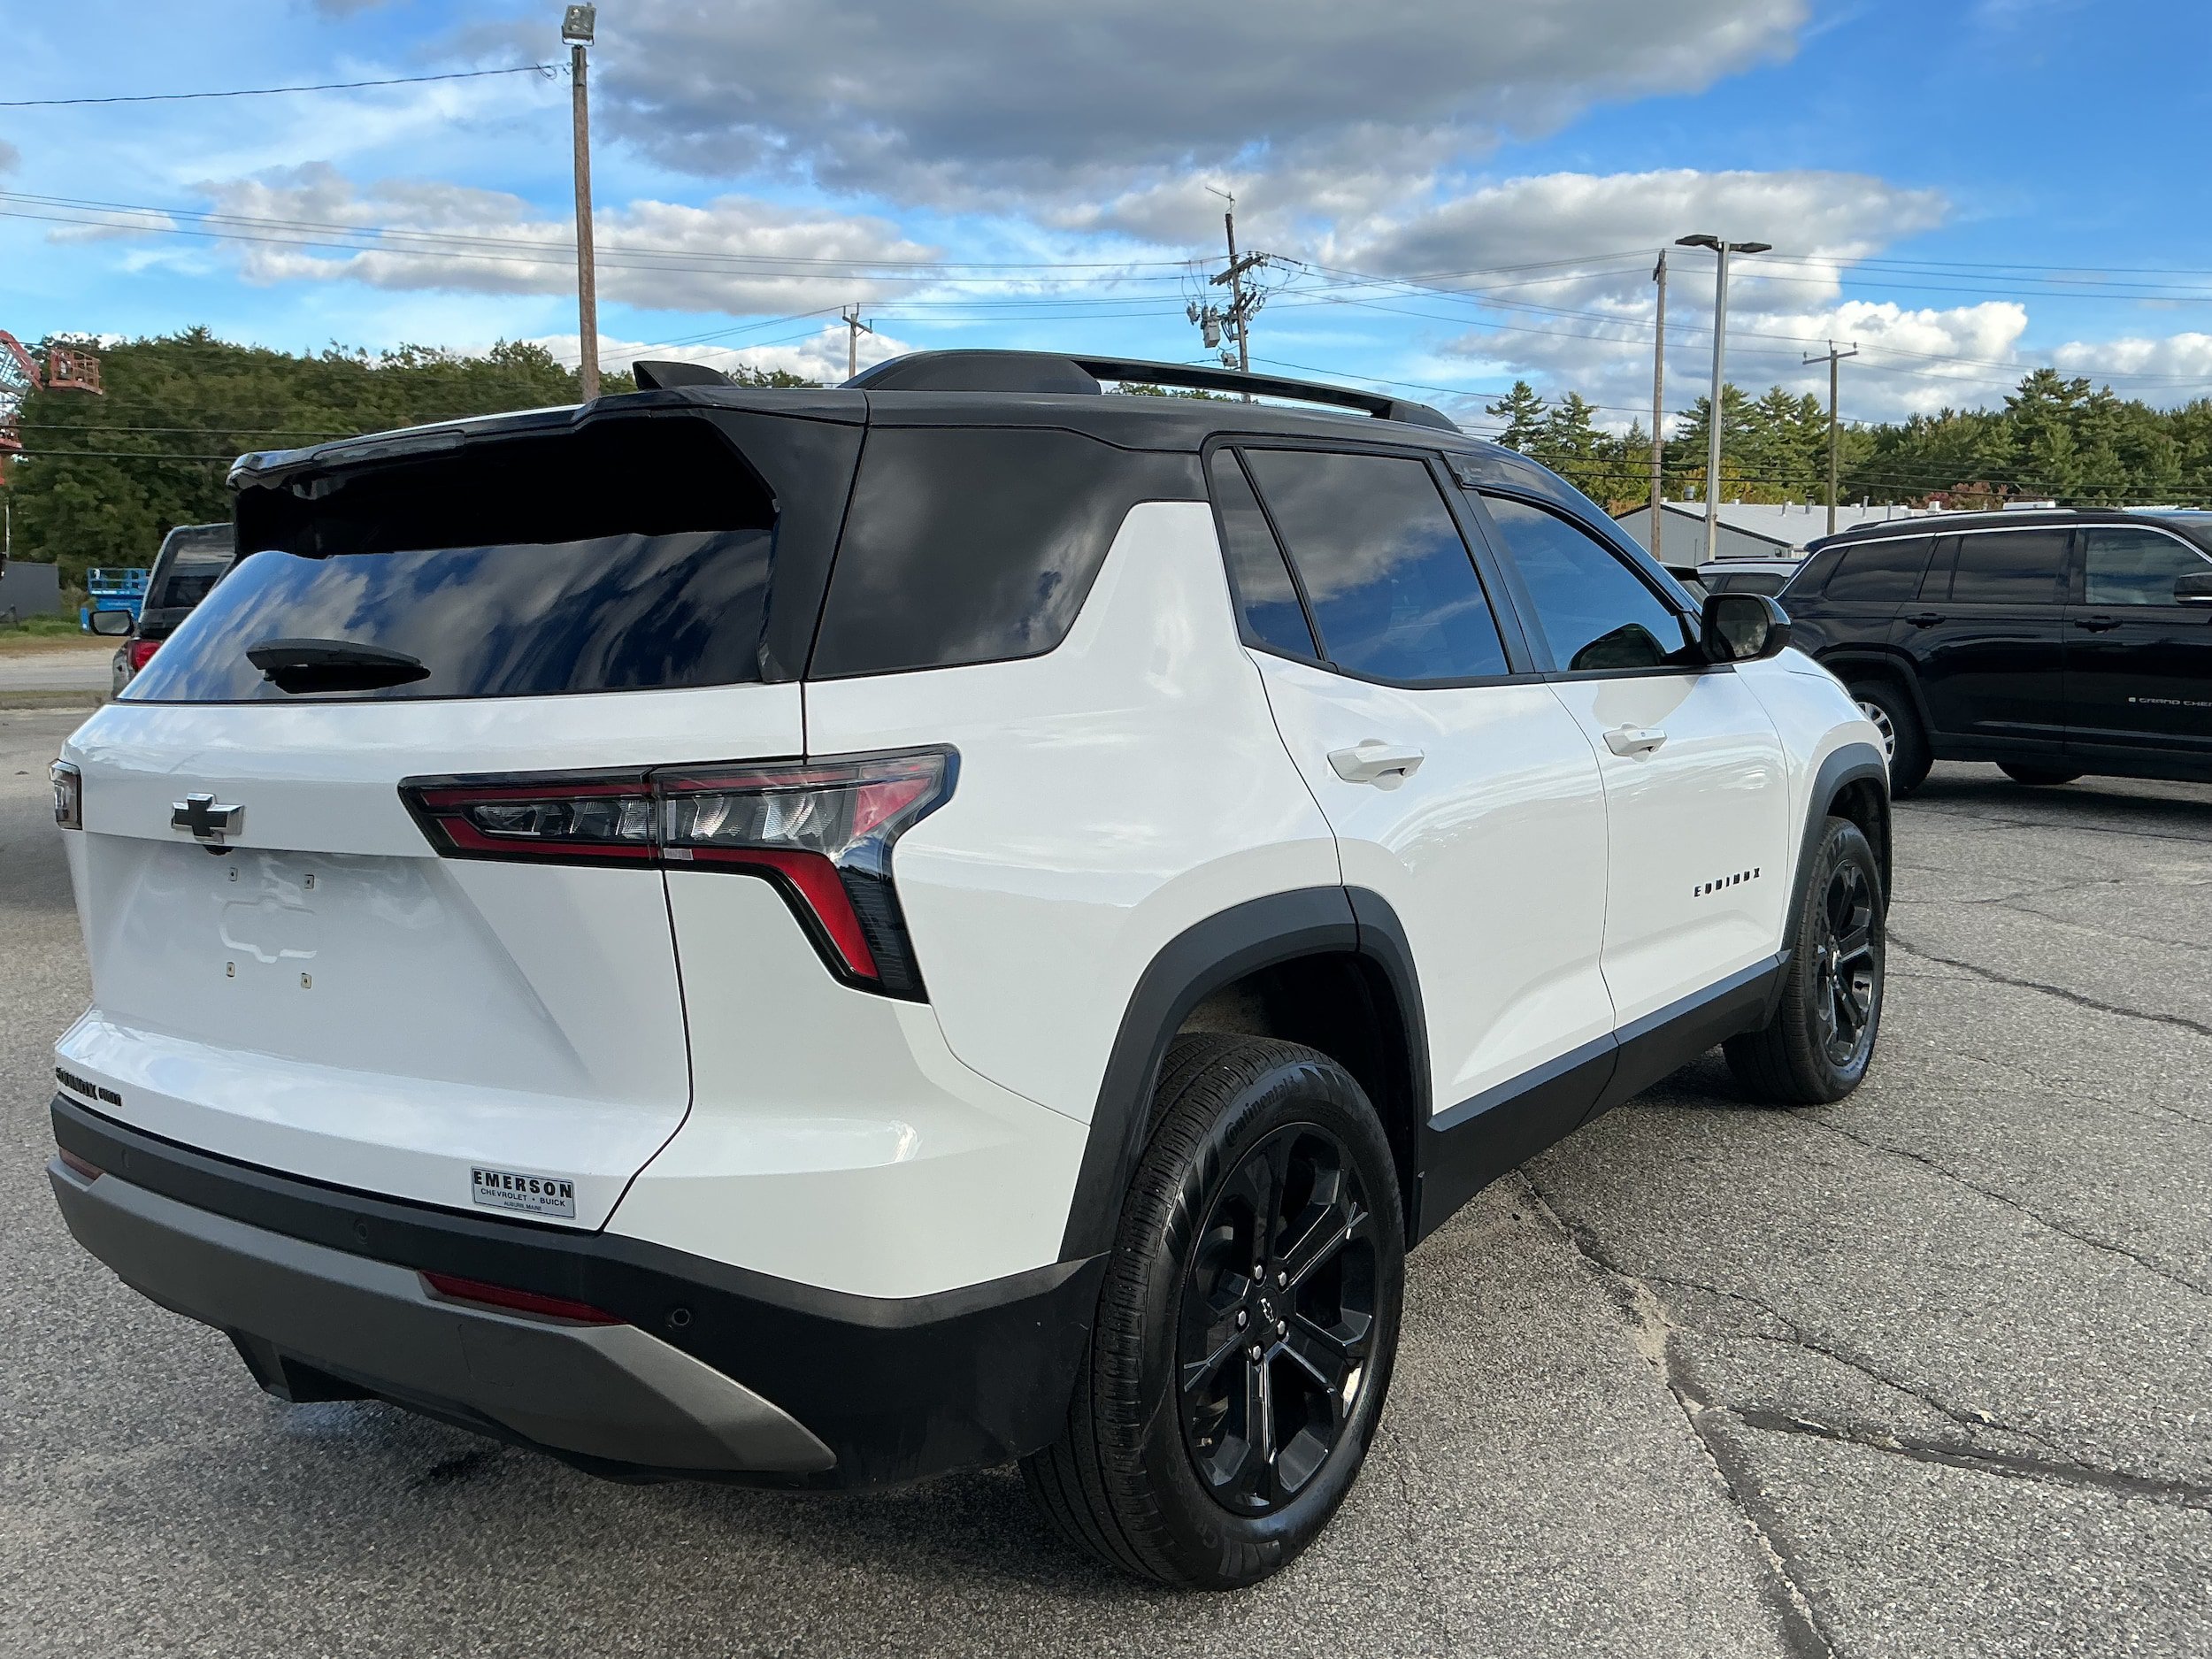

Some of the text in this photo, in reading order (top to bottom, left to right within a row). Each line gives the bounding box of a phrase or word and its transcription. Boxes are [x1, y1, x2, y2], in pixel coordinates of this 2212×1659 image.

[473, 1171, 572, 1198] EMERSON
[480, 1187, 566, 1207] CHEVROLET BUICK
